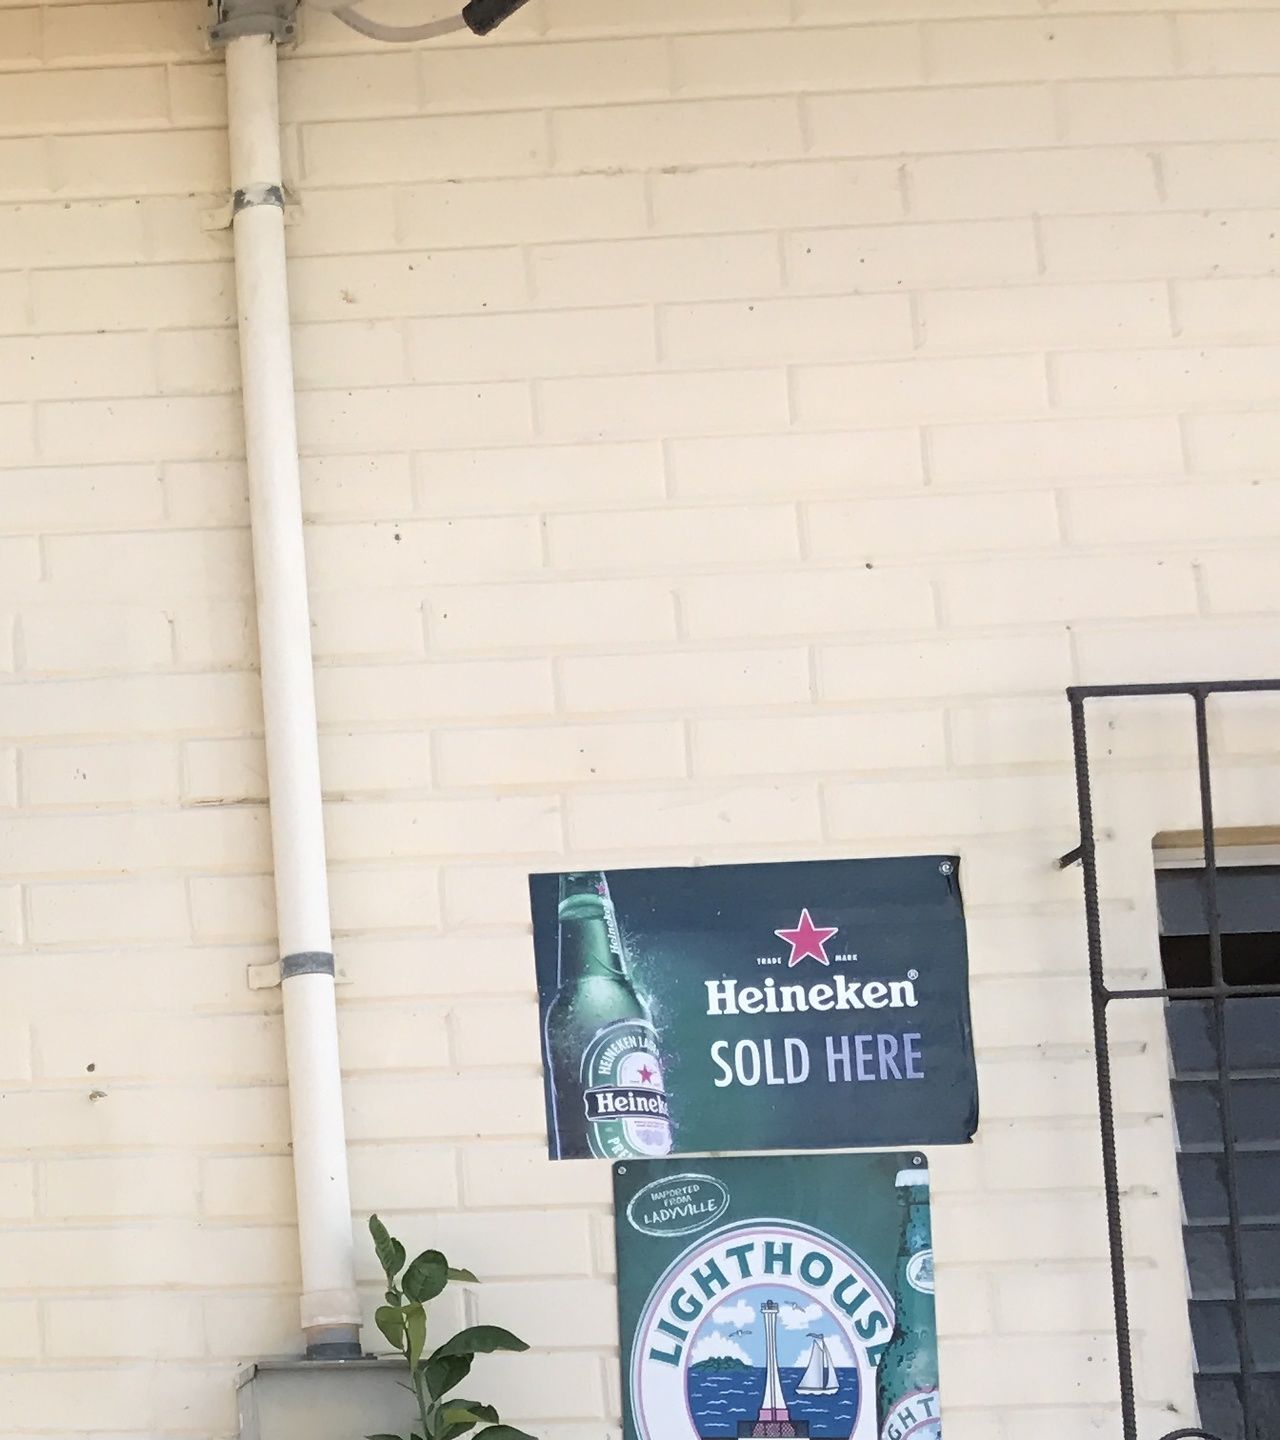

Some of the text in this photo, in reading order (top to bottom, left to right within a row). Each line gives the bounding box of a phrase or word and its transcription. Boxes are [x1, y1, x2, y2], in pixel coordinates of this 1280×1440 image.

[757, 957, 781, 965] TRADE
[704, 974, 918, 1015] Heineken
[598, 1036, 638, 1075] HEINEKEN
[710, 1032, 924, 1087] SOLD HERE
[651, 1184, 700, 1201] IMPORTED
[664, 1195, 692, 1206] FROM
[643, 1198, 717, 1225] LADYVILLE
